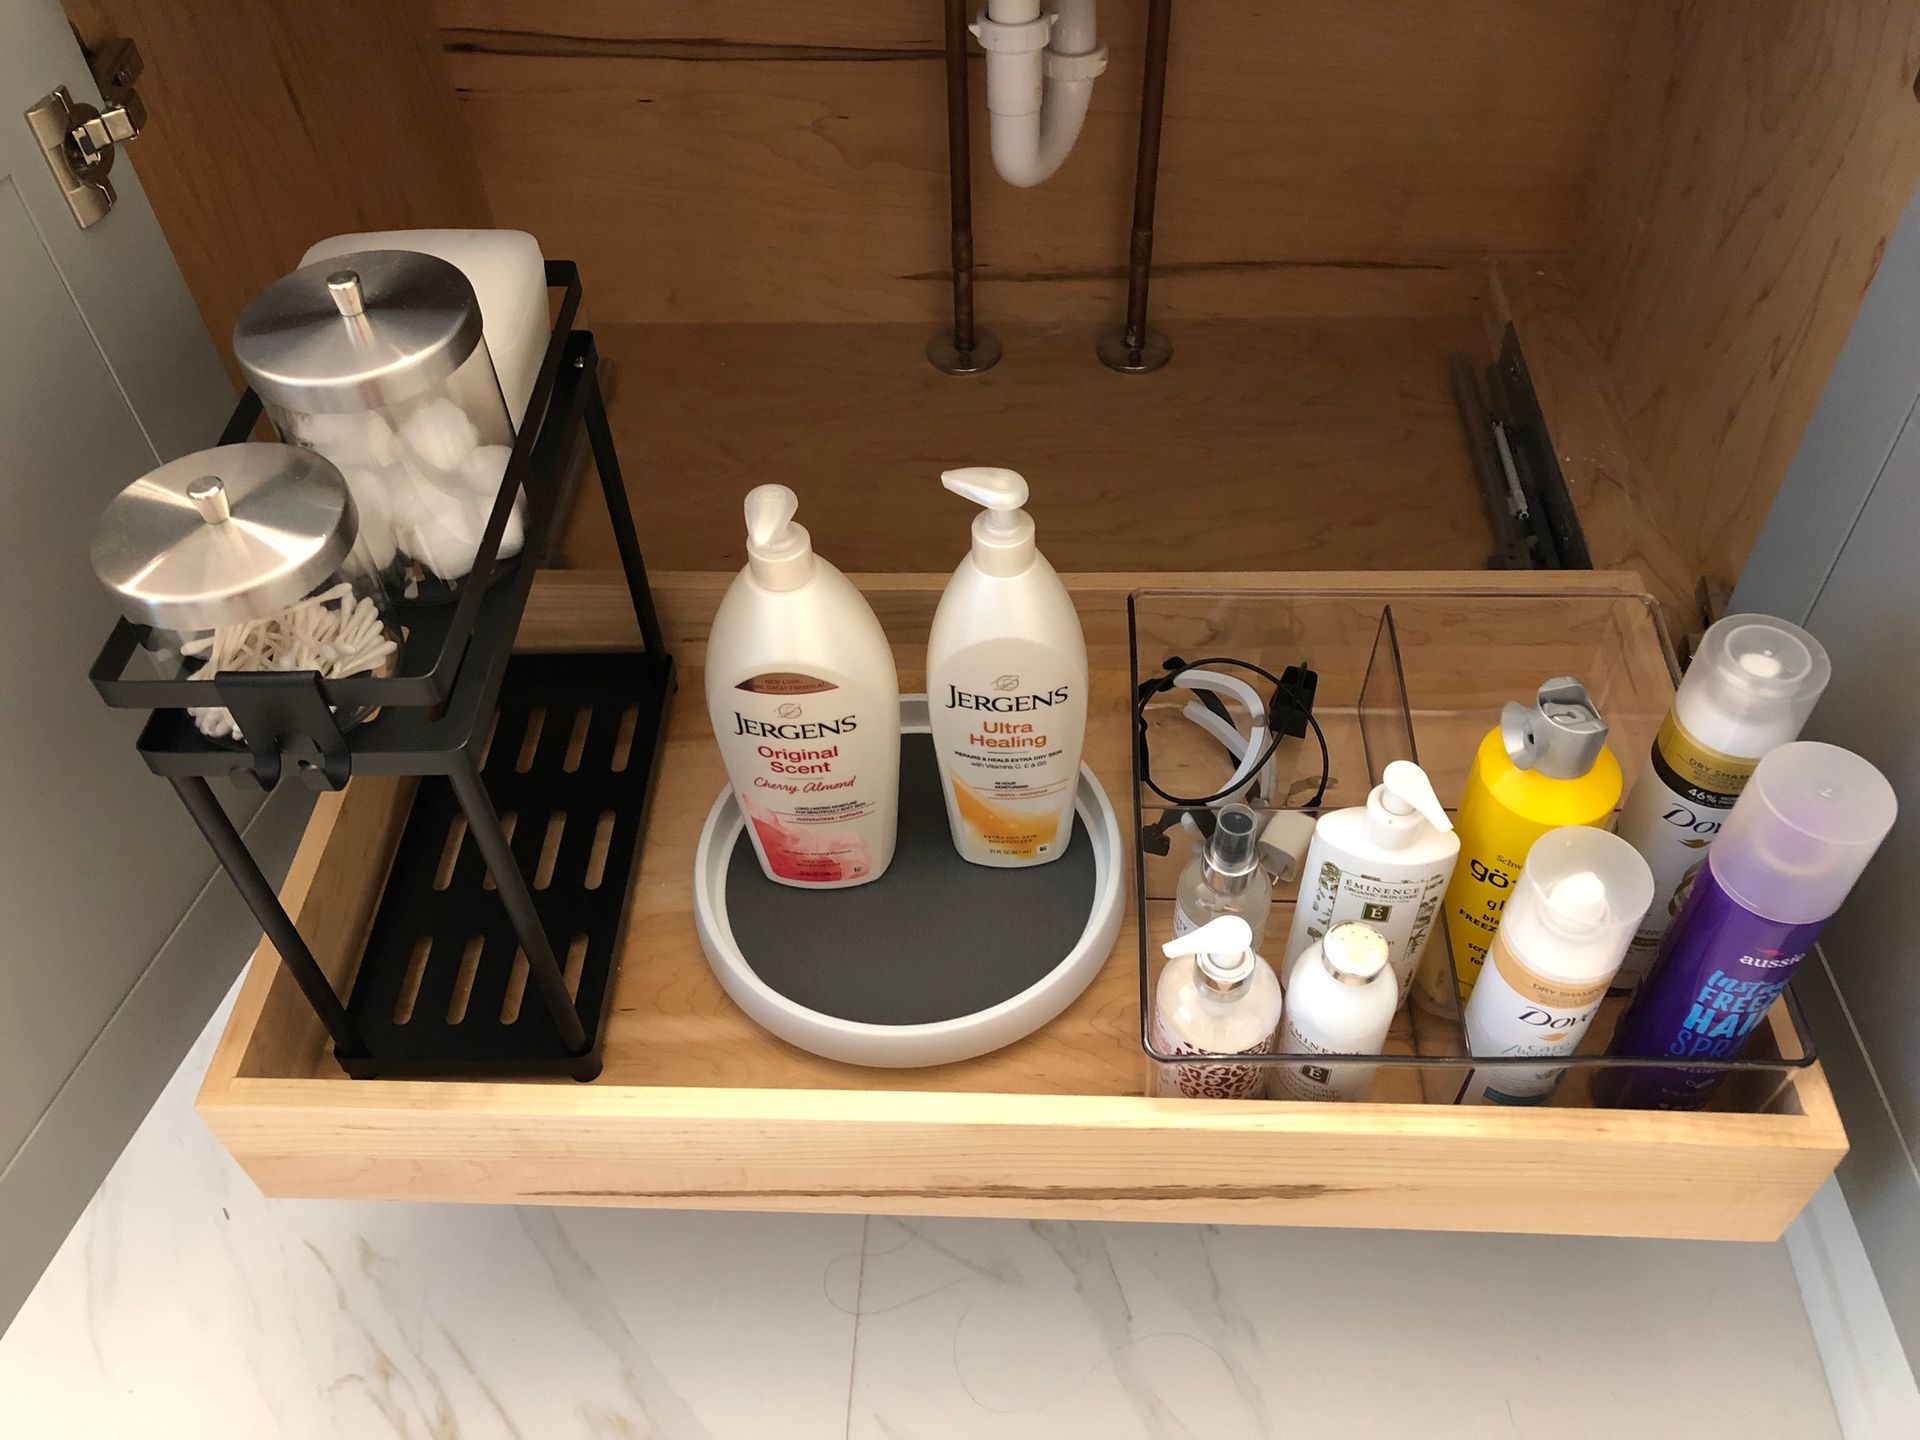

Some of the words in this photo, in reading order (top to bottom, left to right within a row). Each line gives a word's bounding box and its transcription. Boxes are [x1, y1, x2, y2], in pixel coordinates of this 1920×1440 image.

[944, 683, 1069, 713] JERGENS
[733, 711, 857, 740] JERGENS
[983, 721, 1034, 734] Ultra
[969, 733, 1047, 748] Healing
[757, 745, 839, 763] Original
[770, 761, 832, 775] Scent
[753, 776, 799, 794] Cherry
[802, 775, 857, 794] Almond
[1687, 788, 1718, 804] 46%
[1662, 802, 1723, 835] Dov
[1458, 907, 1497, 933] FREEZ
